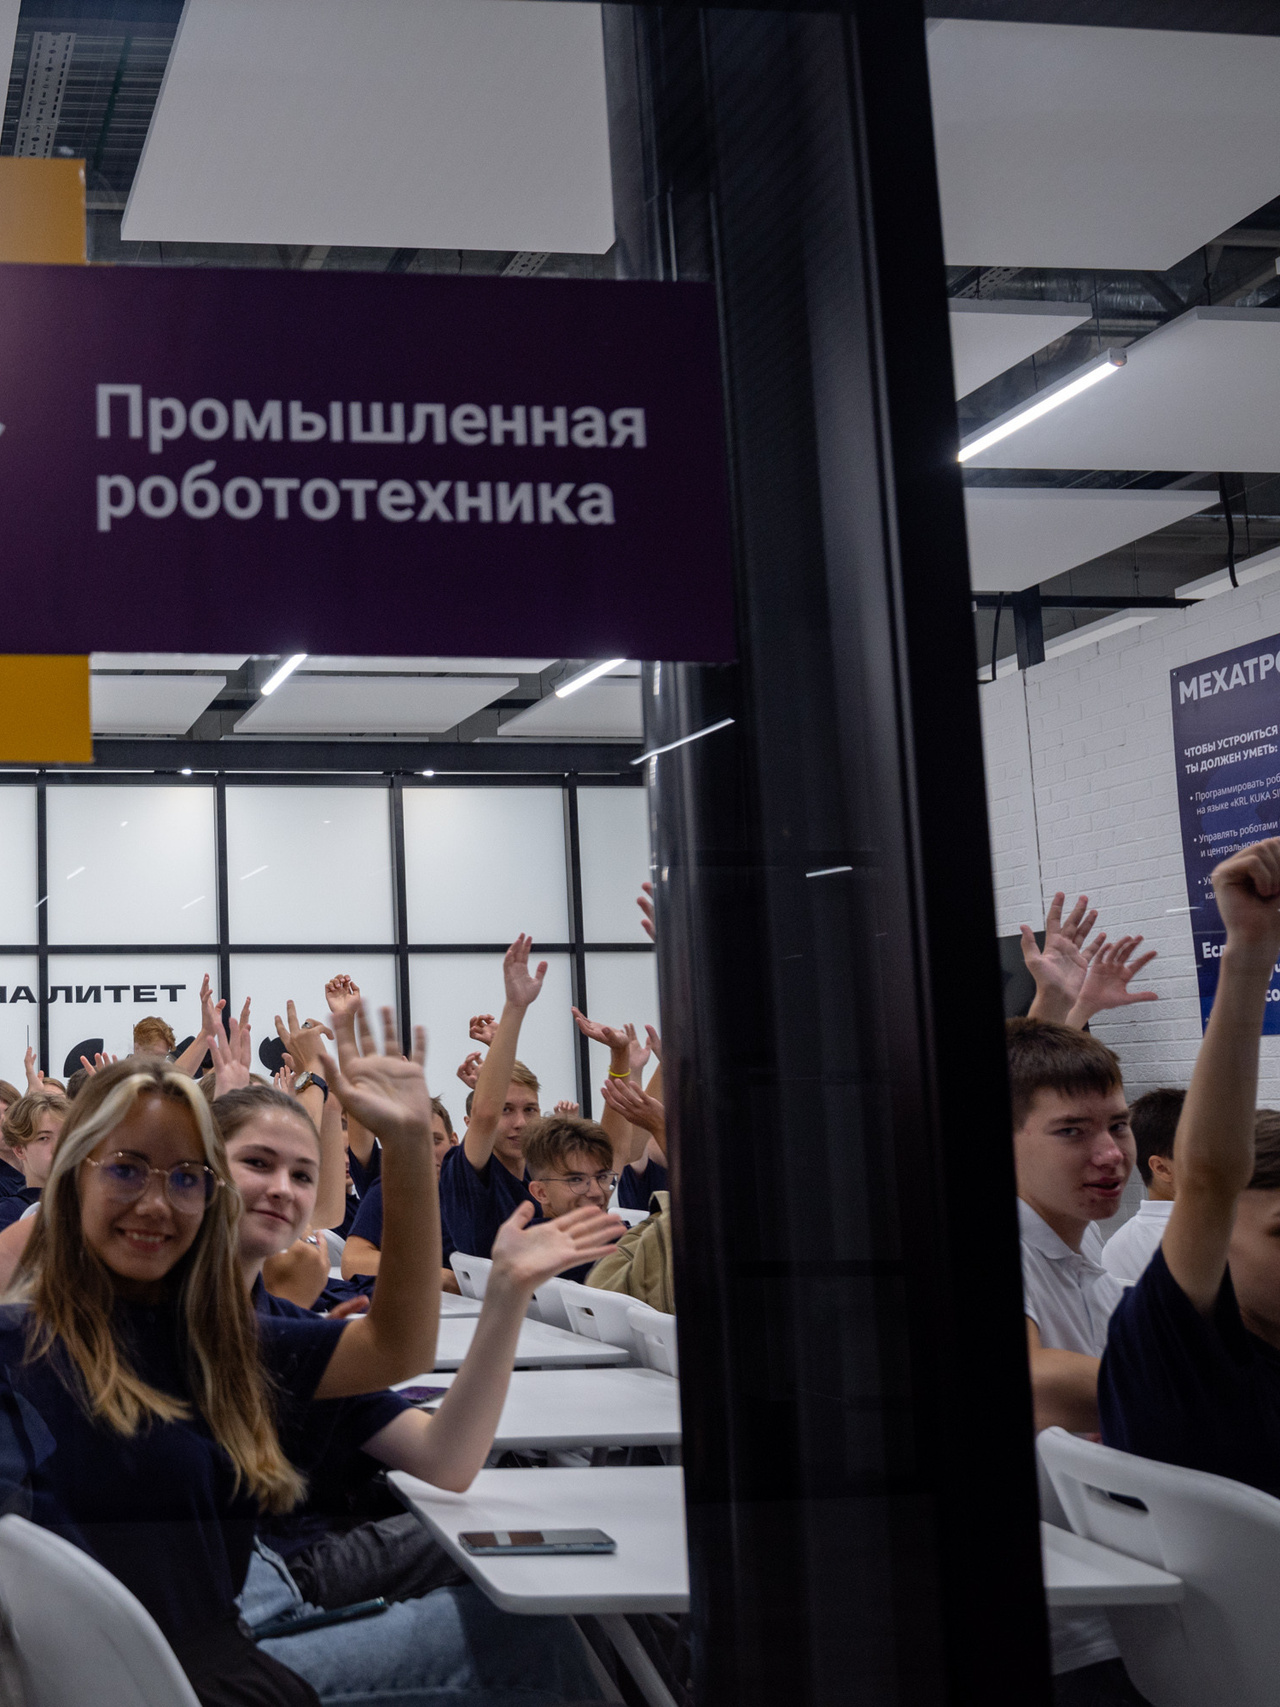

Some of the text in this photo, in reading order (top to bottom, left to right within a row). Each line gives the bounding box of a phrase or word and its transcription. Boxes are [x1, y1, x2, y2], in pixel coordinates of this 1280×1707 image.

[96, 383, 647, 453] Промышленная
[96, 459, 616, 532] робототехника
[1179, 650, 1280, 705] МЕХАТР
[1184, 725, 1279, 758] ЧТОБЫ УСТРОИТЬСЯ
[1185, 743, 1278, 775] ТЫ ДОЛЖЕН УМЕТЬ:
[1195, 780, 1265, 802] Программировать
[1207, 801, 1229, 813] языке
[1250, 791, 1271, 803] KUKA
[1199, 820, 1278, 844] Управлять роботами
